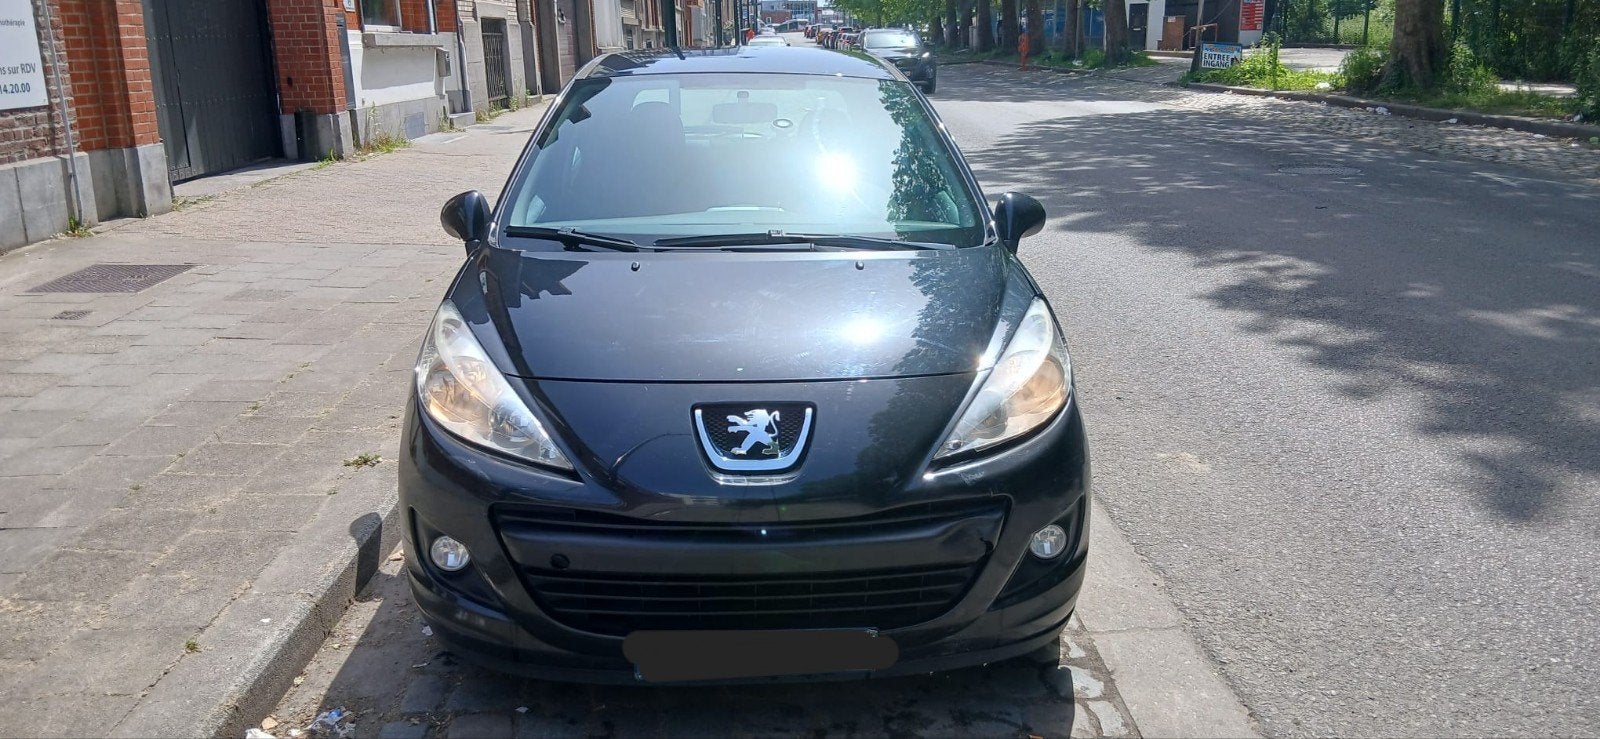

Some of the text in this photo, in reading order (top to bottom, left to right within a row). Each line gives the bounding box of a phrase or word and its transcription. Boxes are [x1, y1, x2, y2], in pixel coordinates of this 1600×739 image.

[0, 18, 25, 28] othérapie
[8, 66, 19, 74] sur
[20, 62, 36, 74] RDV
[1203, 60, 1230, 68] INGANG
